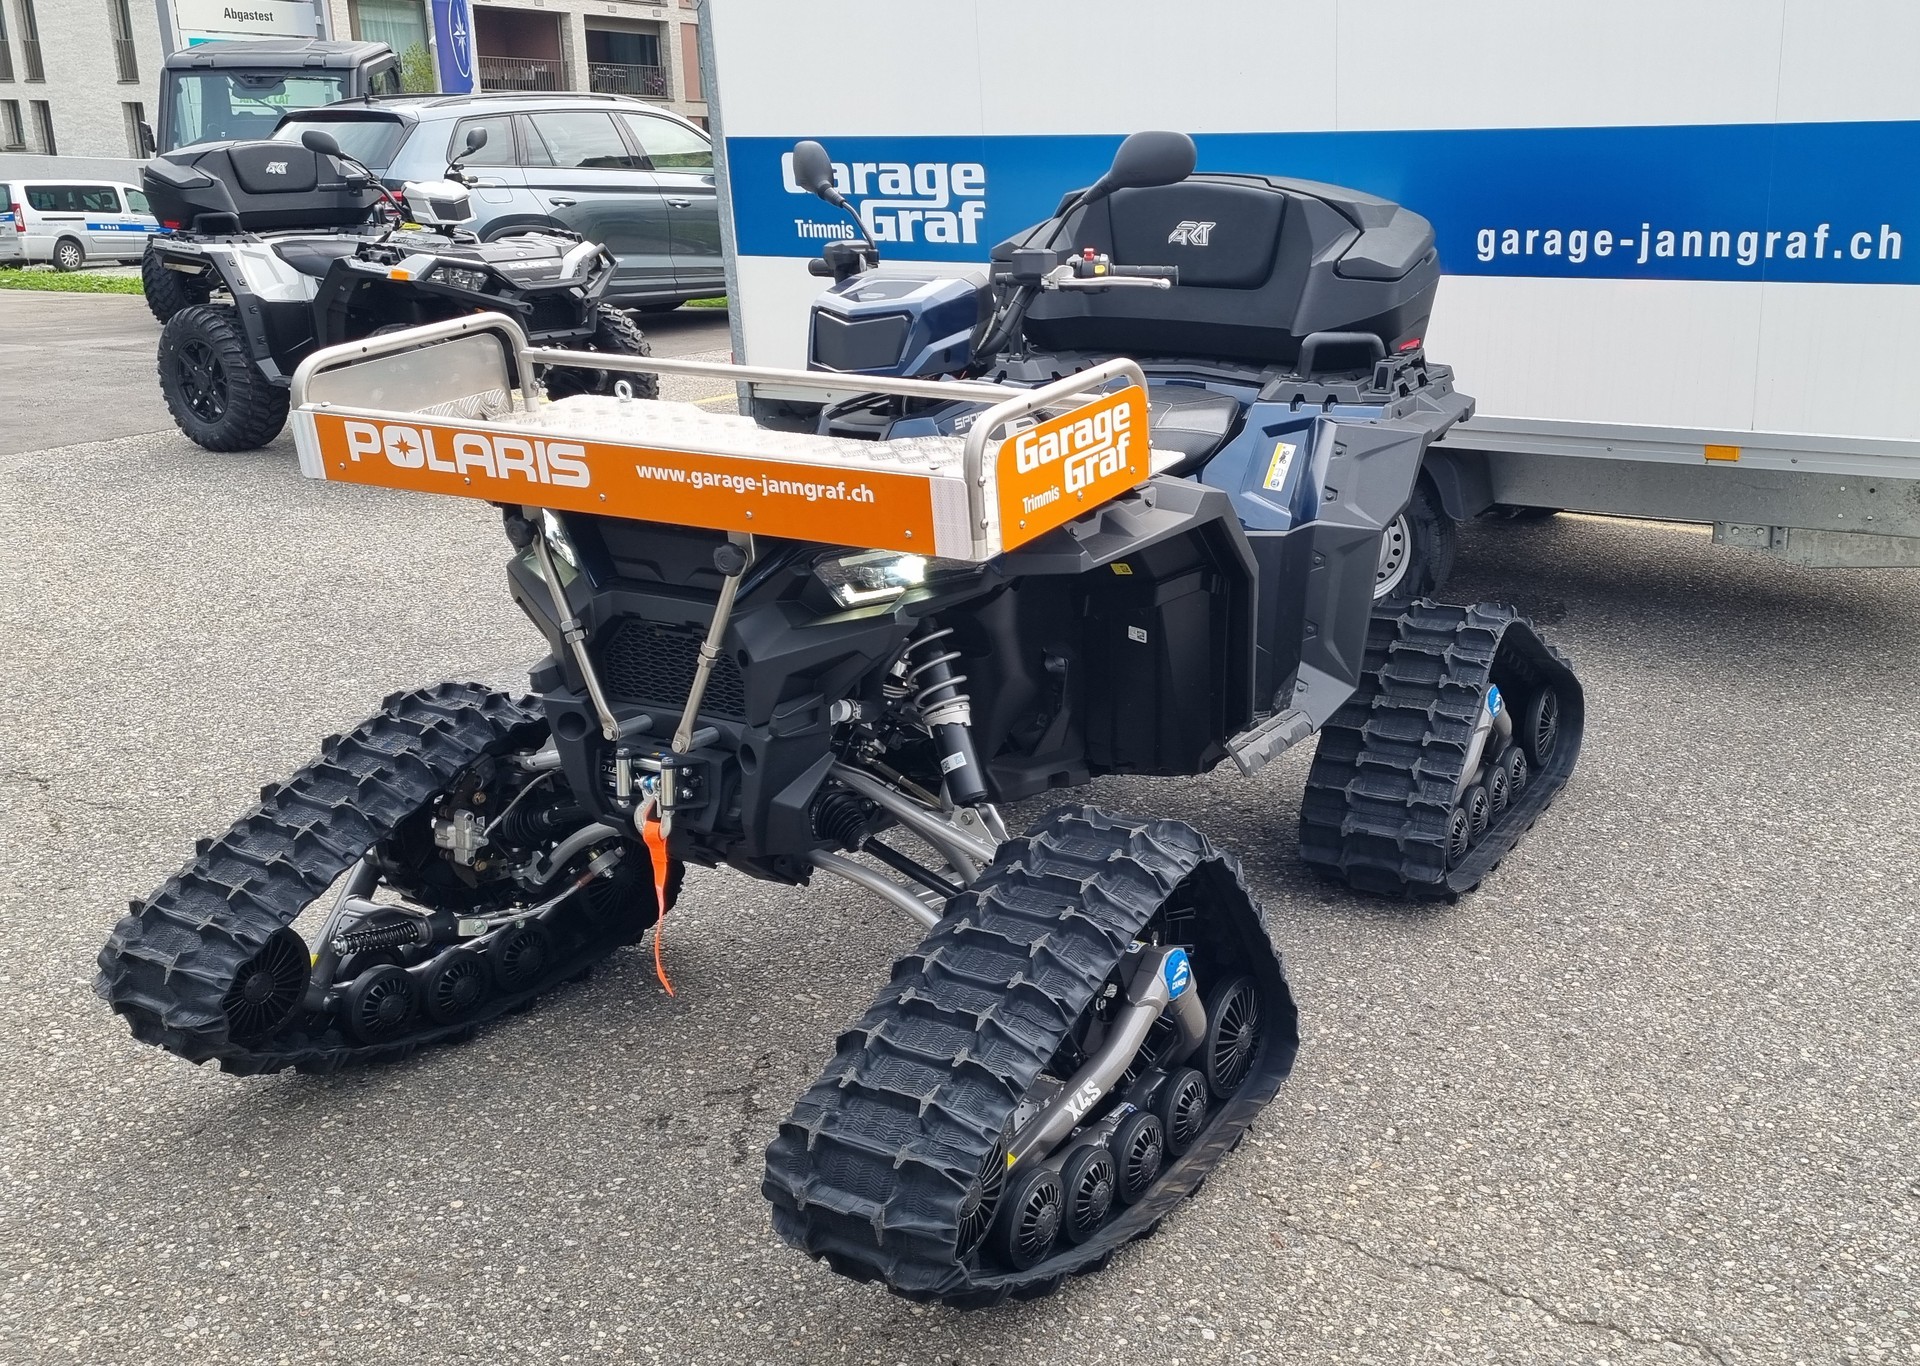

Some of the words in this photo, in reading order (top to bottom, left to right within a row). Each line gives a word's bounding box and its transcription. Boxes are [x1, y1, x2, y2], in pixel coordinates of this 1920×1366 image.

[223, 7, 274, 22] Abgastest
[794, 219, 855, 240] Trimmis
[860, 200, 985, 244] Graf
[1476, 222, 1902, 266] garage-janngraf.ch
[344, 421, 590, 488] POLARIS
[1015, 402, 1130, 474] Garage
[635, 465, 875, 503] www.garage-janngraf.ch
[1064, 431, 1130, 494] Graf
[1022, 485, 1060, 515] Trimmis
[1064, 1080, 1102, 1122] X4S
